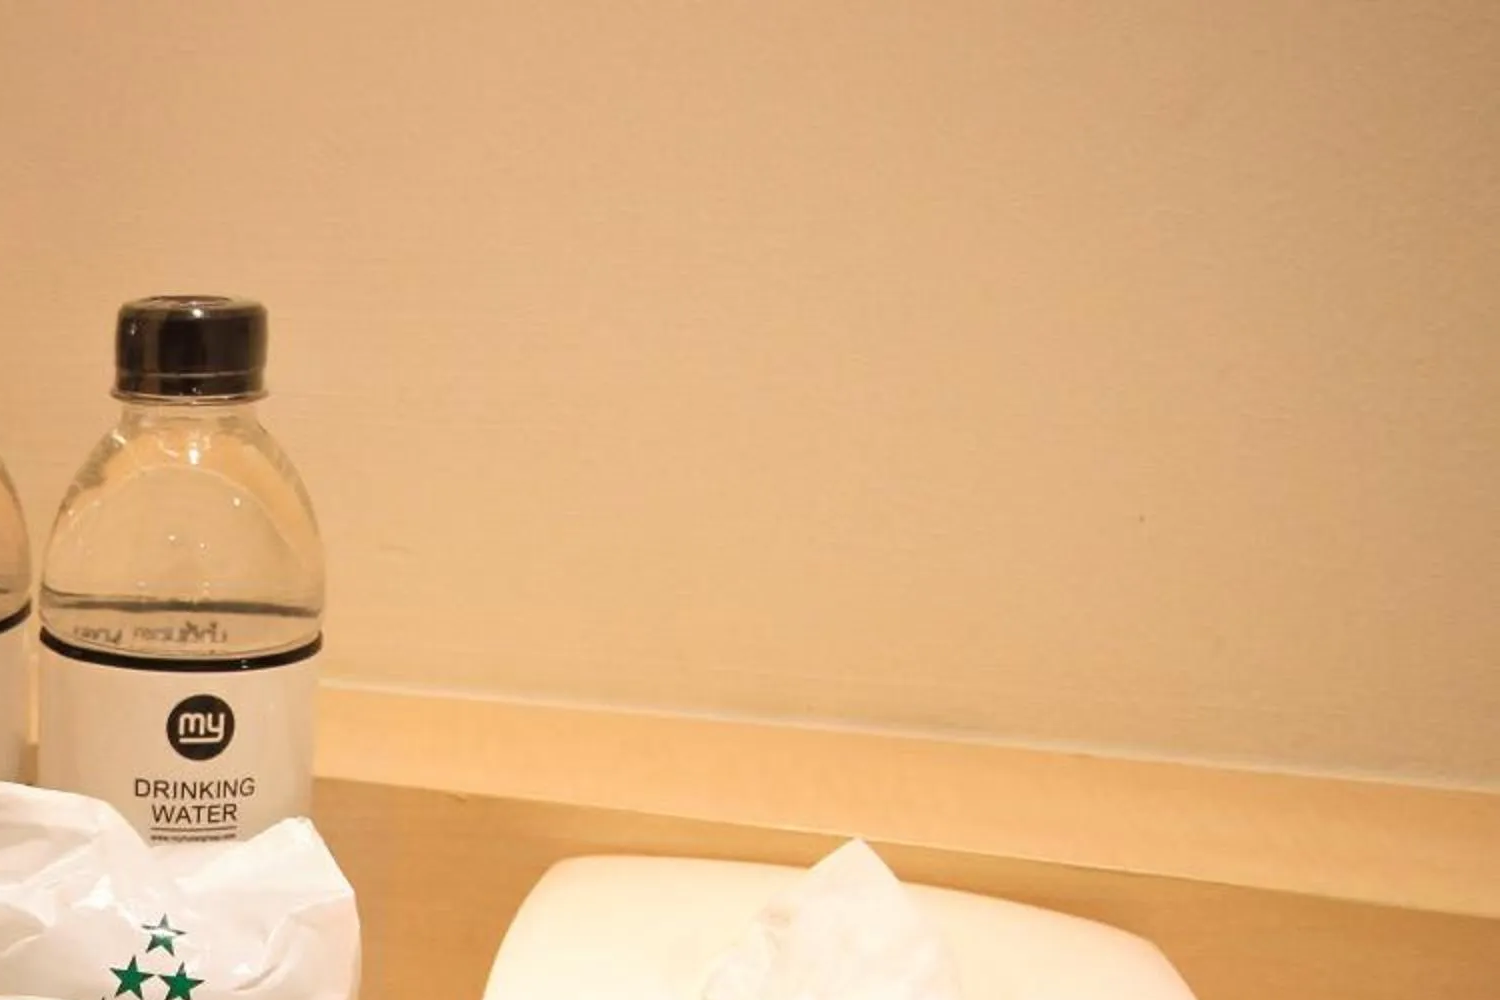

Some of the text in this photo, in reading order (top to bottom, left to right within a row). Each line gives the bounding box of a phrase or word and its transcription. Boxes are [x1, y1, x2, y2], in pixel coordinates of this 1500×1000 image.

[178, 712, 225, 743] my
[134, 777, 256, 800] DRINKING
[151, 803, 237, 823] WATER
